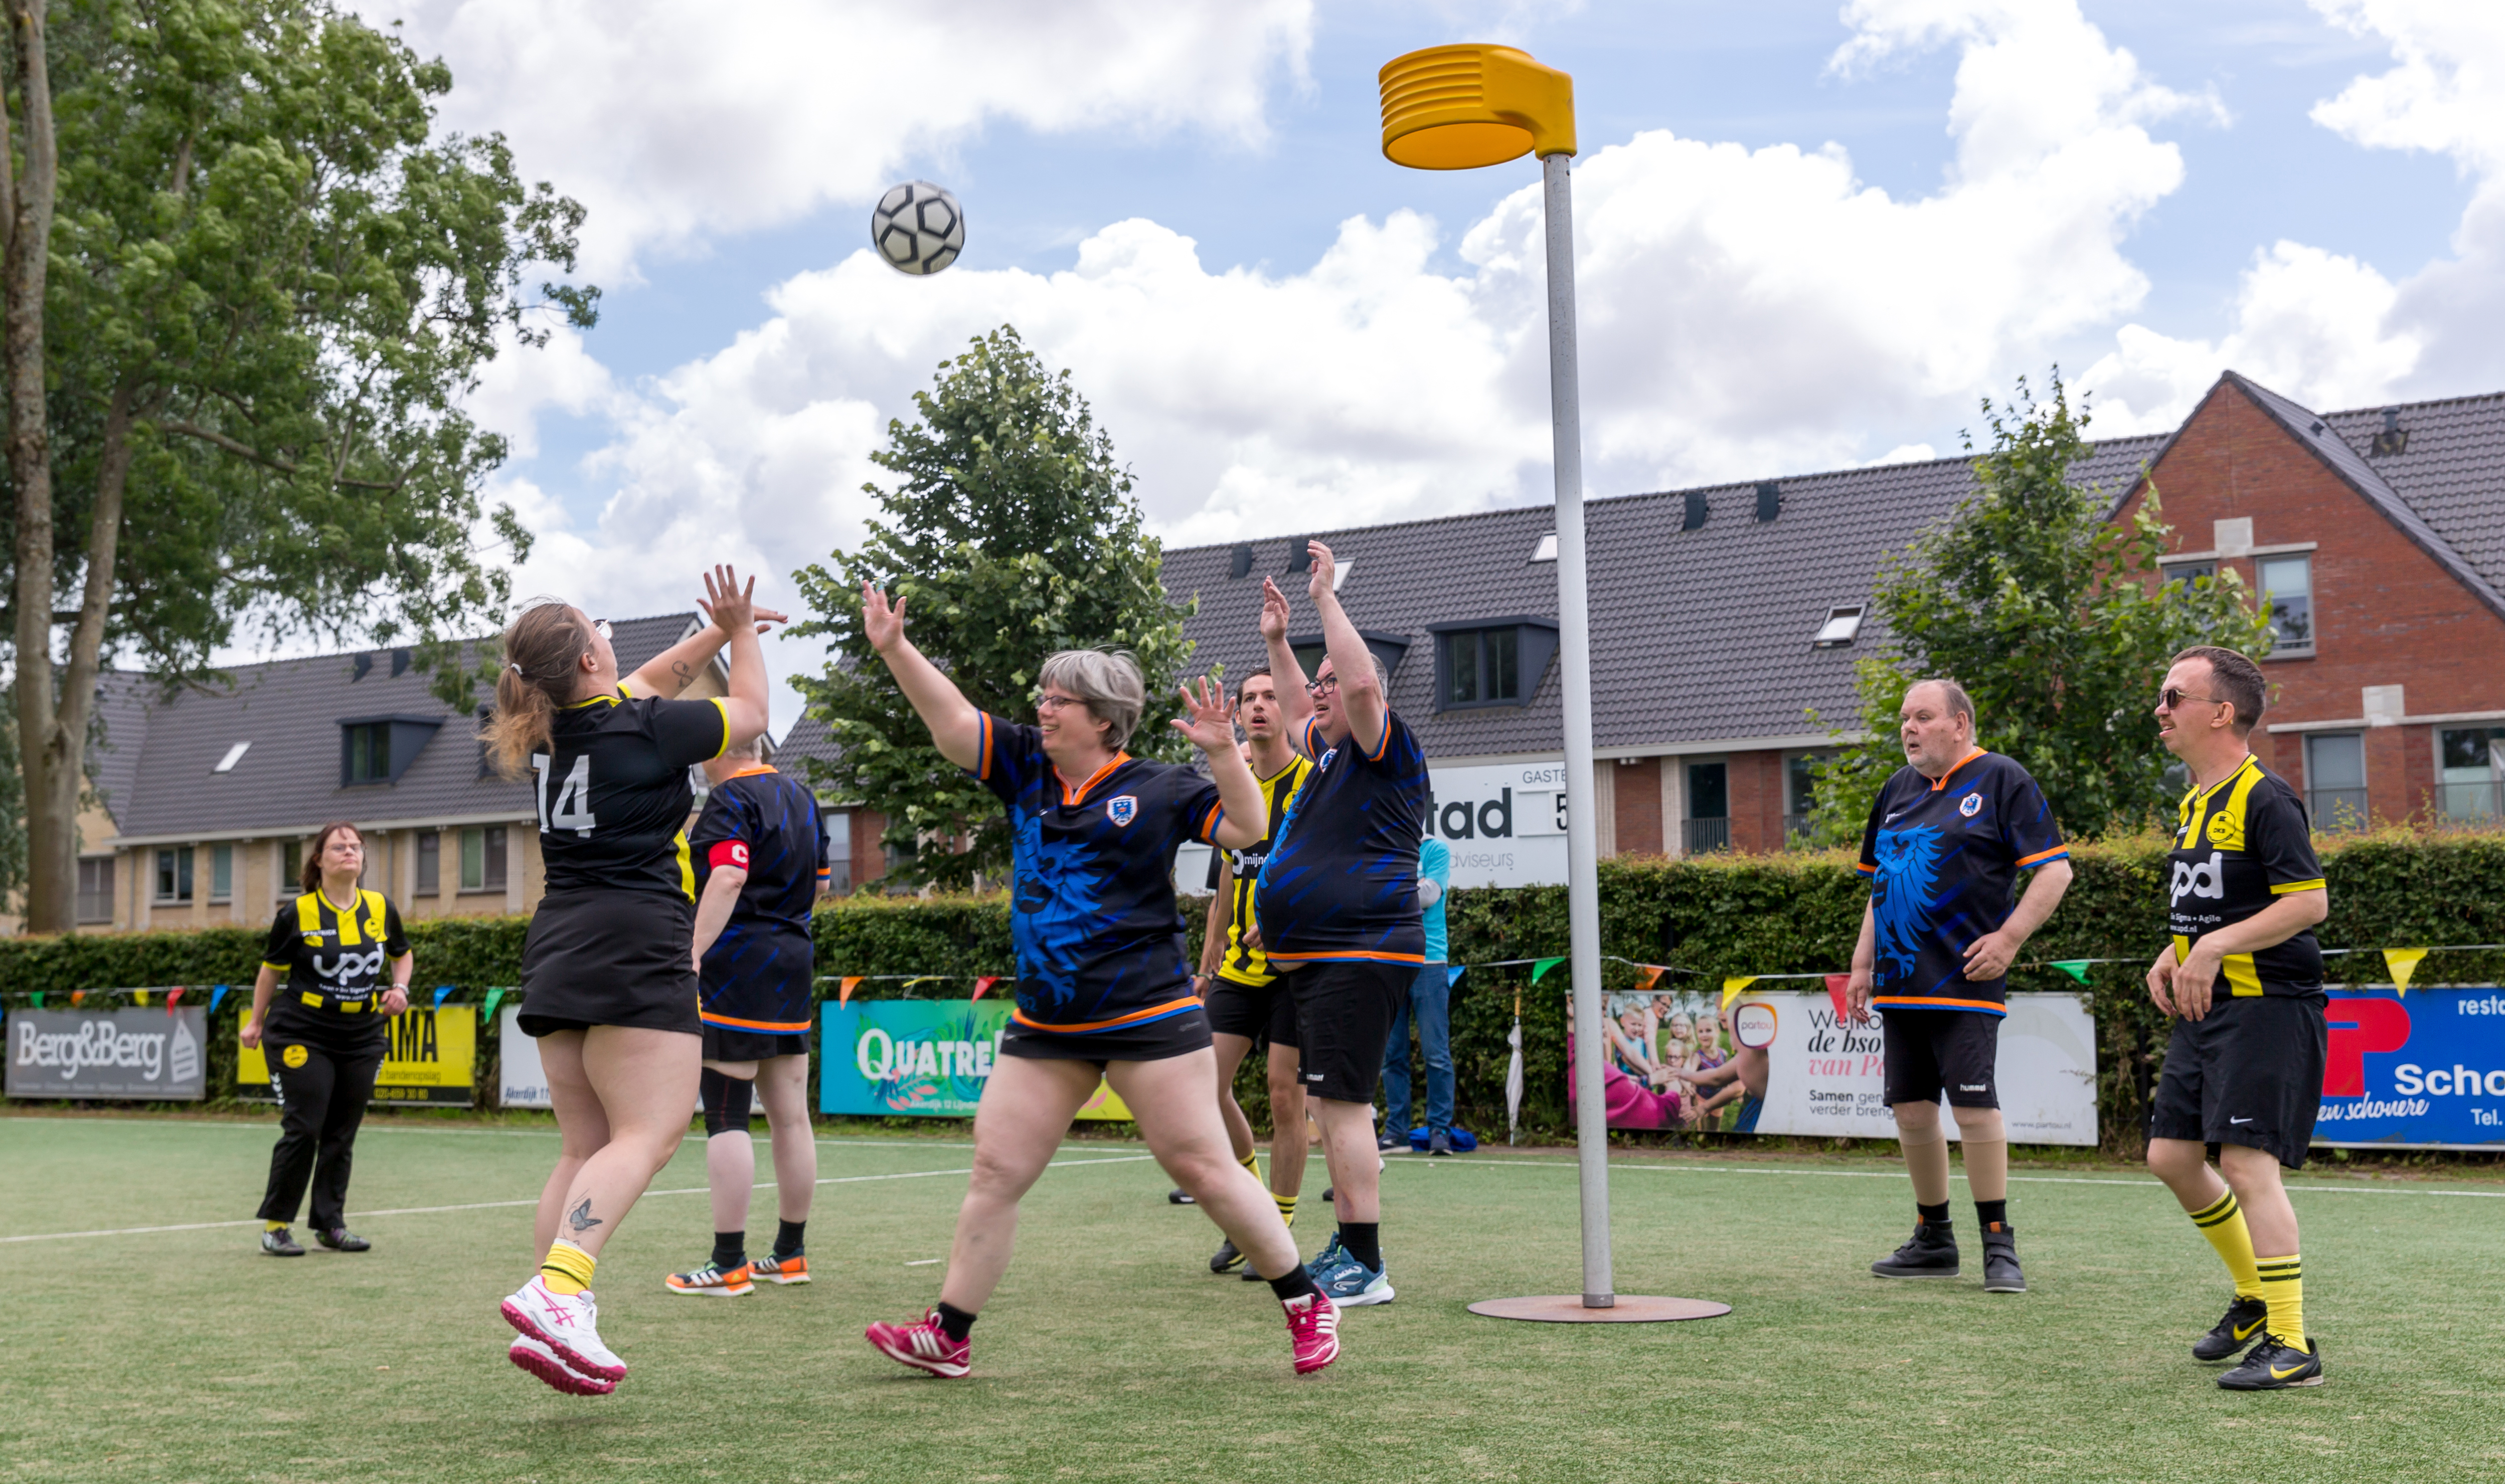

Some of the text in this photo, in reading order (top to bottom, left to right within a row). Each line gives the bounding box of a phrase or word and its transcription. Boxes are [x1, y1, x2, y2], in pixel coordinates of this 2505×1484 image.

[533, 753, 596, 838] 14
[1557, 794, 1567, 830] 5
[732, 844, 747, 863] C
[2198, 915, 2221, 923] Agile
[1741, 1020, 1772, 1031] partou
[1808, 1029, 1881, 1053] de bso
[17, 1020, 166, 1081] Berg&Berg
[1809, 1059, 1852, 1076] van
[1809, 1089, 1854, 1102] Samen
[1960, 1083, 1986, 1092] hummel
[1809, 1103, 1895, 1121] verder breng
[2470, 1108, 2503, 1126] Tel.
[2012, 1121, 2072, 1129] www.partou.nl
